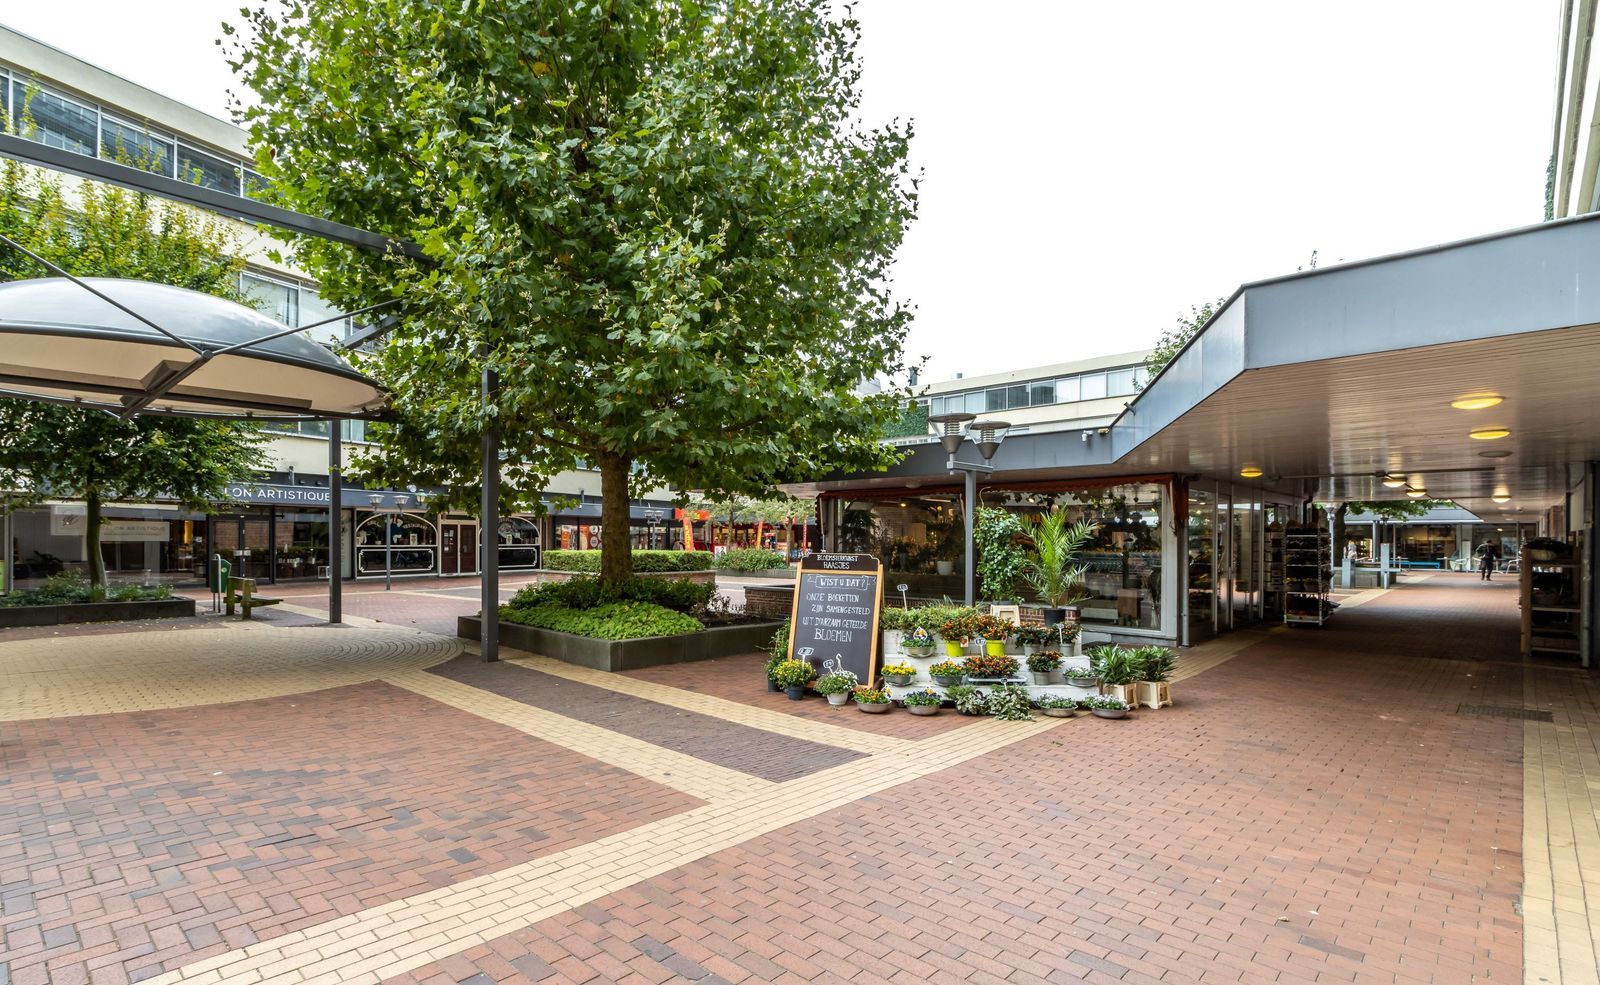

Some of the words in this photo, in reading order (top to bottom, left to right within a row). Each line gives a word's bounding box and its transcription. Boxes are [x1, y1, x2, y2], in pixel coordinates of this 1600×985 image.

[224, 487, 252, 498] LON
[257, 489, 330, 501] ARTISTIQUE
[823, 561, 850, 569] HAASJES
[820, 578, 839, 586] WIST
[839, 578, 845, 586] U
[806, 592, 825, 601] ONZE
[827, 593, 860, 602] BOEKETTEN
[811, 603, 824, 613] ZIJN
[825, 604, 871, 615] SAMENGESTELD
[814, 628, 853, 642] BLOEMEN
